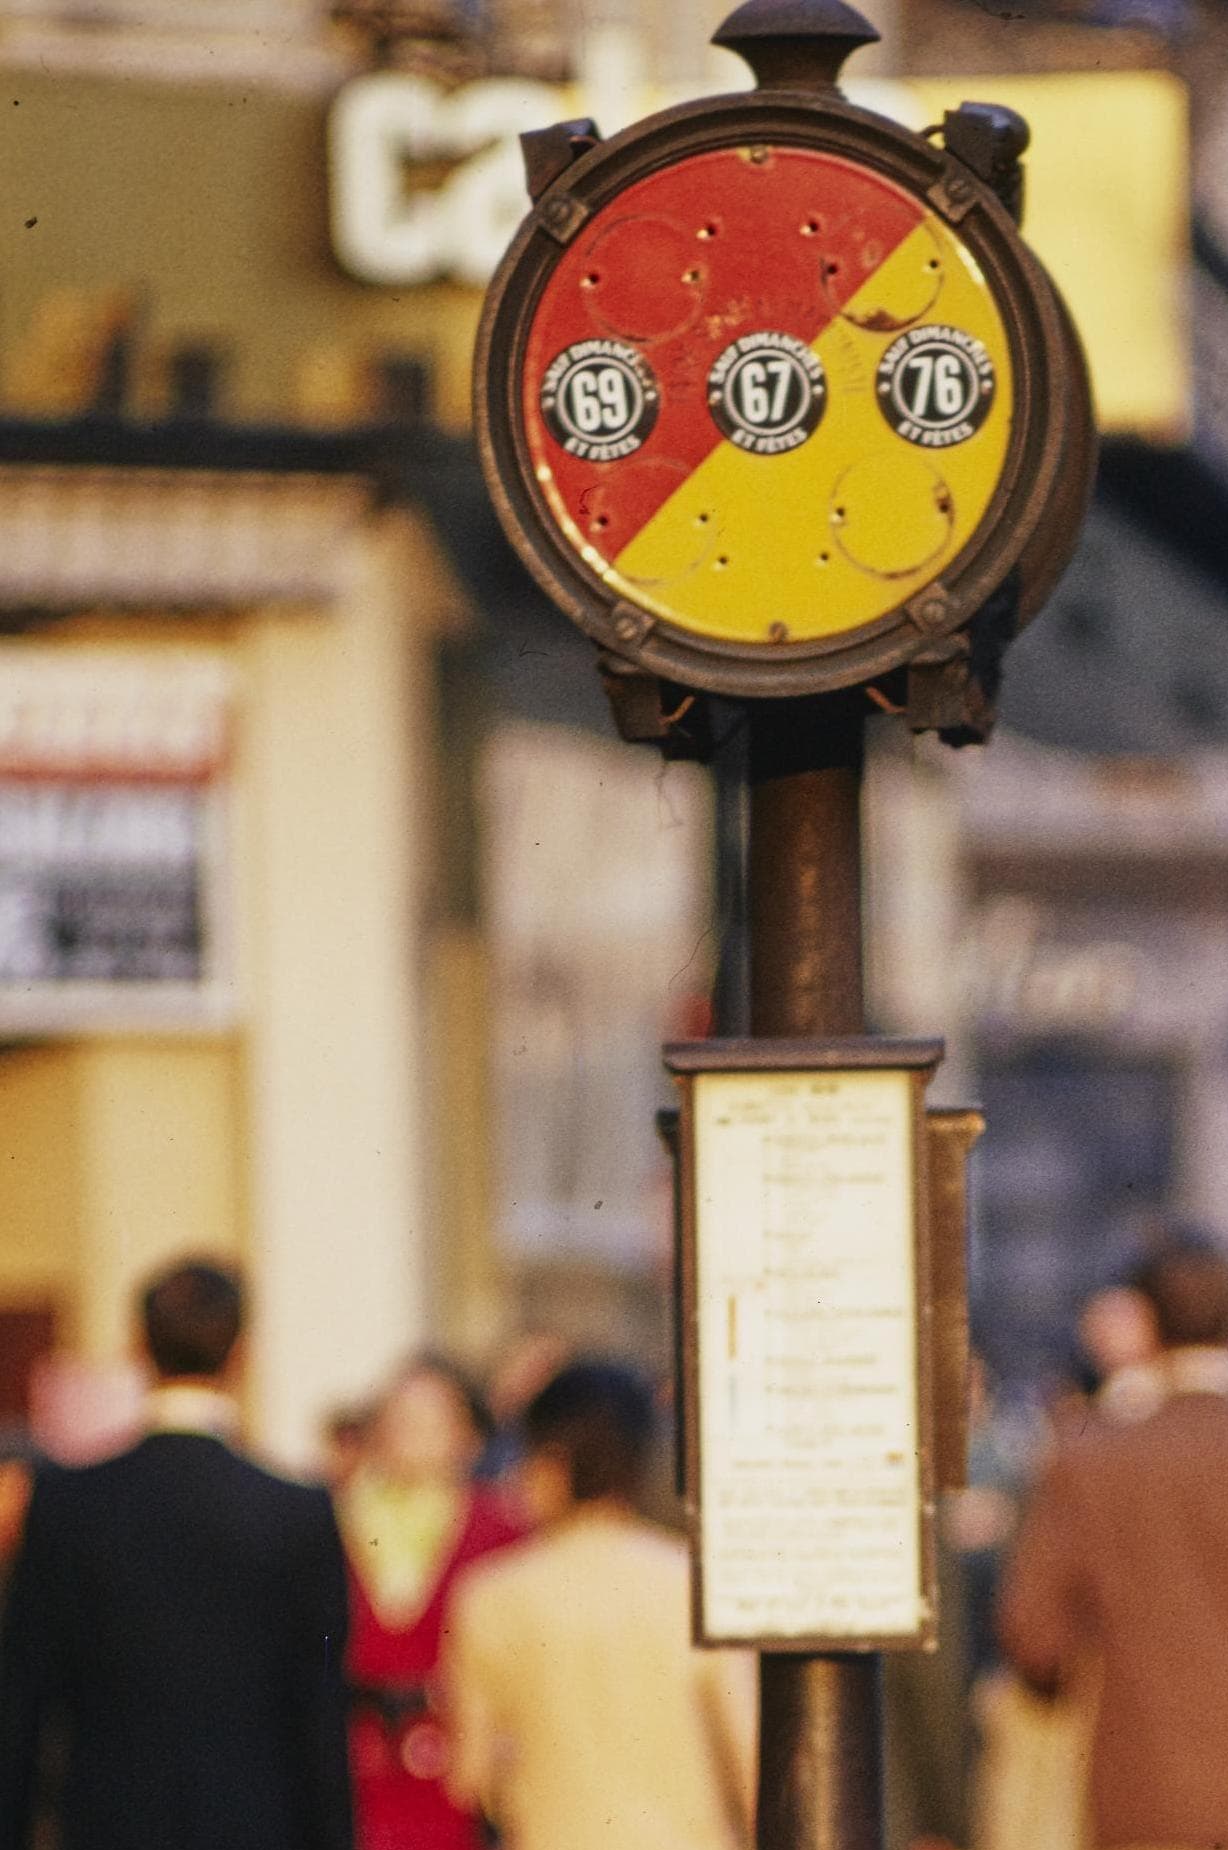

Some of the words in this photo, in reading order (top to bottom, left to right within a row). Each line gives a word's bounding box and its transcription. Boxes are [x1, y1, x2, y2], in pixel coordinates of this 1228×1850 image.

[541, 352, 572, 393] SAUF
[708, 344, 739, 384] SAUF
[736, 331, 824, 380] DIMANCHES
[879, 337, 910, 375] SAUF
[907, 325, 993, 375] DIMANCHES
[571, 367, 629, 432] 69
[740, 360, 792, 423] 67
[908, 354, 963, 416] 76
[563, 436, 590, 458] ET
[732, 428, 757, 449] ET
[898, 420, 923, 441] ET
